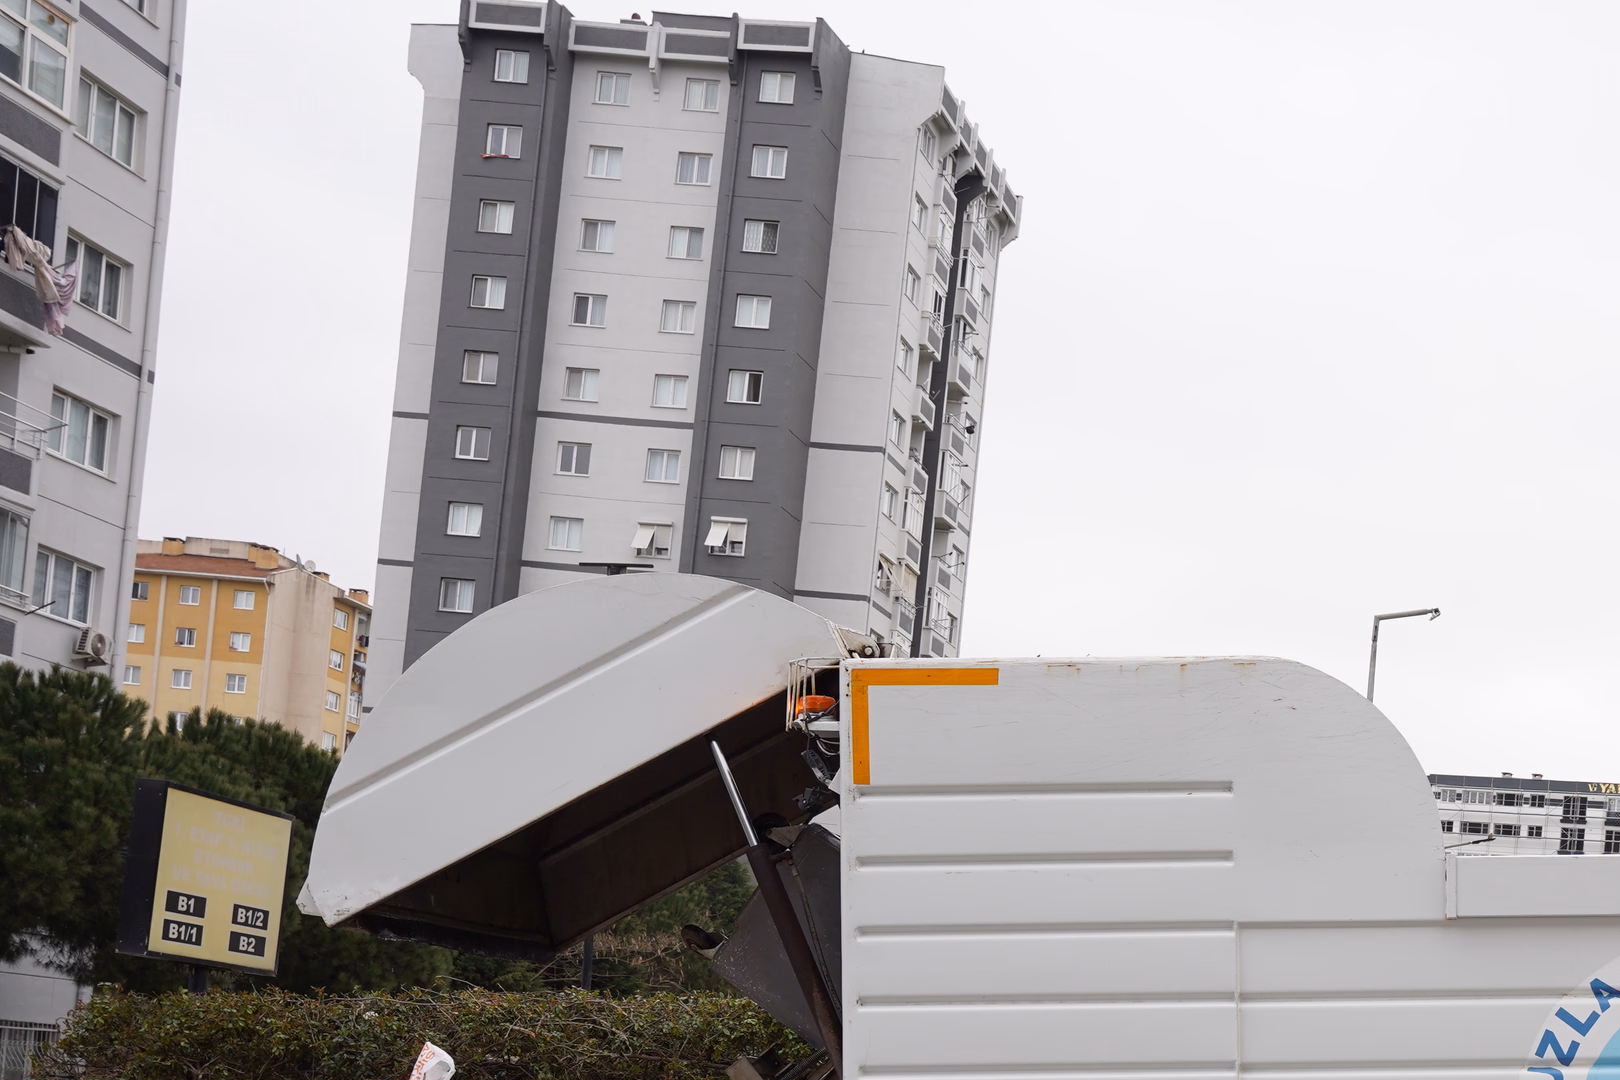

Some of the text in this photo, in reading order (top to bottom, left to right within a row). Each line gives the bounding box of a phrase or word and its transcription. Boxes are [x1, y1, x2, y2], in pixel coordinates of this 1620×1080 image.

[177, 896, 195, 913] B1
[237, 908, 264, 927] B1/2
[169, 923, 197, 942] B1/1
[239, 936, 255, 952] B2
